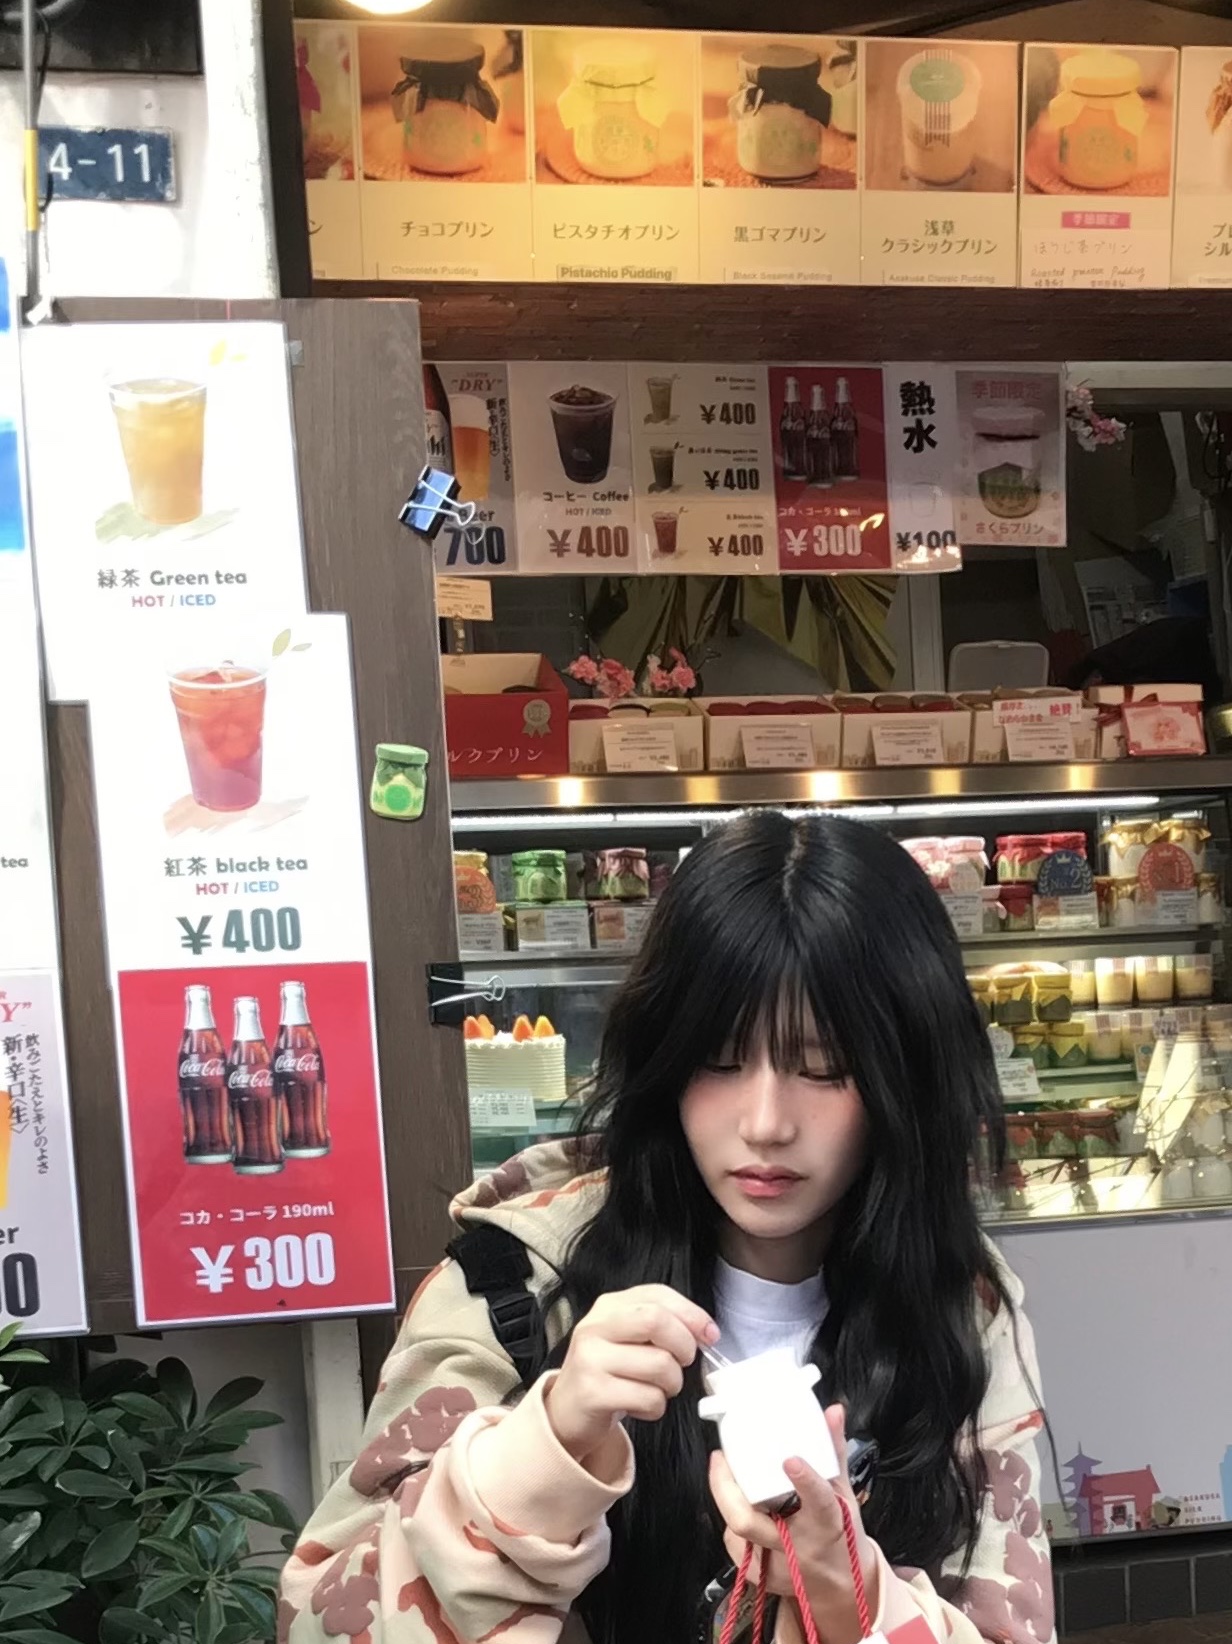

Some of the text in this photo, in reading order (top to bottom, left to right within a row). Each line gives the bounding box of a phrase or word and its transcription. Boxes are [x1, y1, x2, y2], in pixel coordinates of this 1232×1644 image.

[47, 142, 153, 182] 4-11
[400, 220, 494, 239] チョコプリン
[552, 222, 680, 242] ピスタチオプリン
[733, 225, 828, 243] 黒ゴマプリン
[923, 219, 955, 237] 浅草
[881, 237, 999, 255] クラシックプリン
[391, 265, 479, 278] Chocolate Pudding
[560, 265, 673, 282] Pistachio Pudding
[971, 379, 1042, 399] 季節限定
[899, 380, 938, 454] 熱水
[542, 491, 630, 503] コーヒー Coffee
[565, 508, 584, 516] HOT
[975, 521, 1045, 535] さくらプリン
[896, 529, 957, 551] ¥100
[96, 567, 248, 590] 緑茶 Green tea
[131, 594, 165, 608] HOT
[179, 593, 217, 607] ICED
[163, 854, 309, 878] 紅茶 black tea
[195, 881, 229, 896] HOT
[242, 879, 280, 894] ICED
[179, 1201, 335, 1225] コカ・コーラ 190ml
